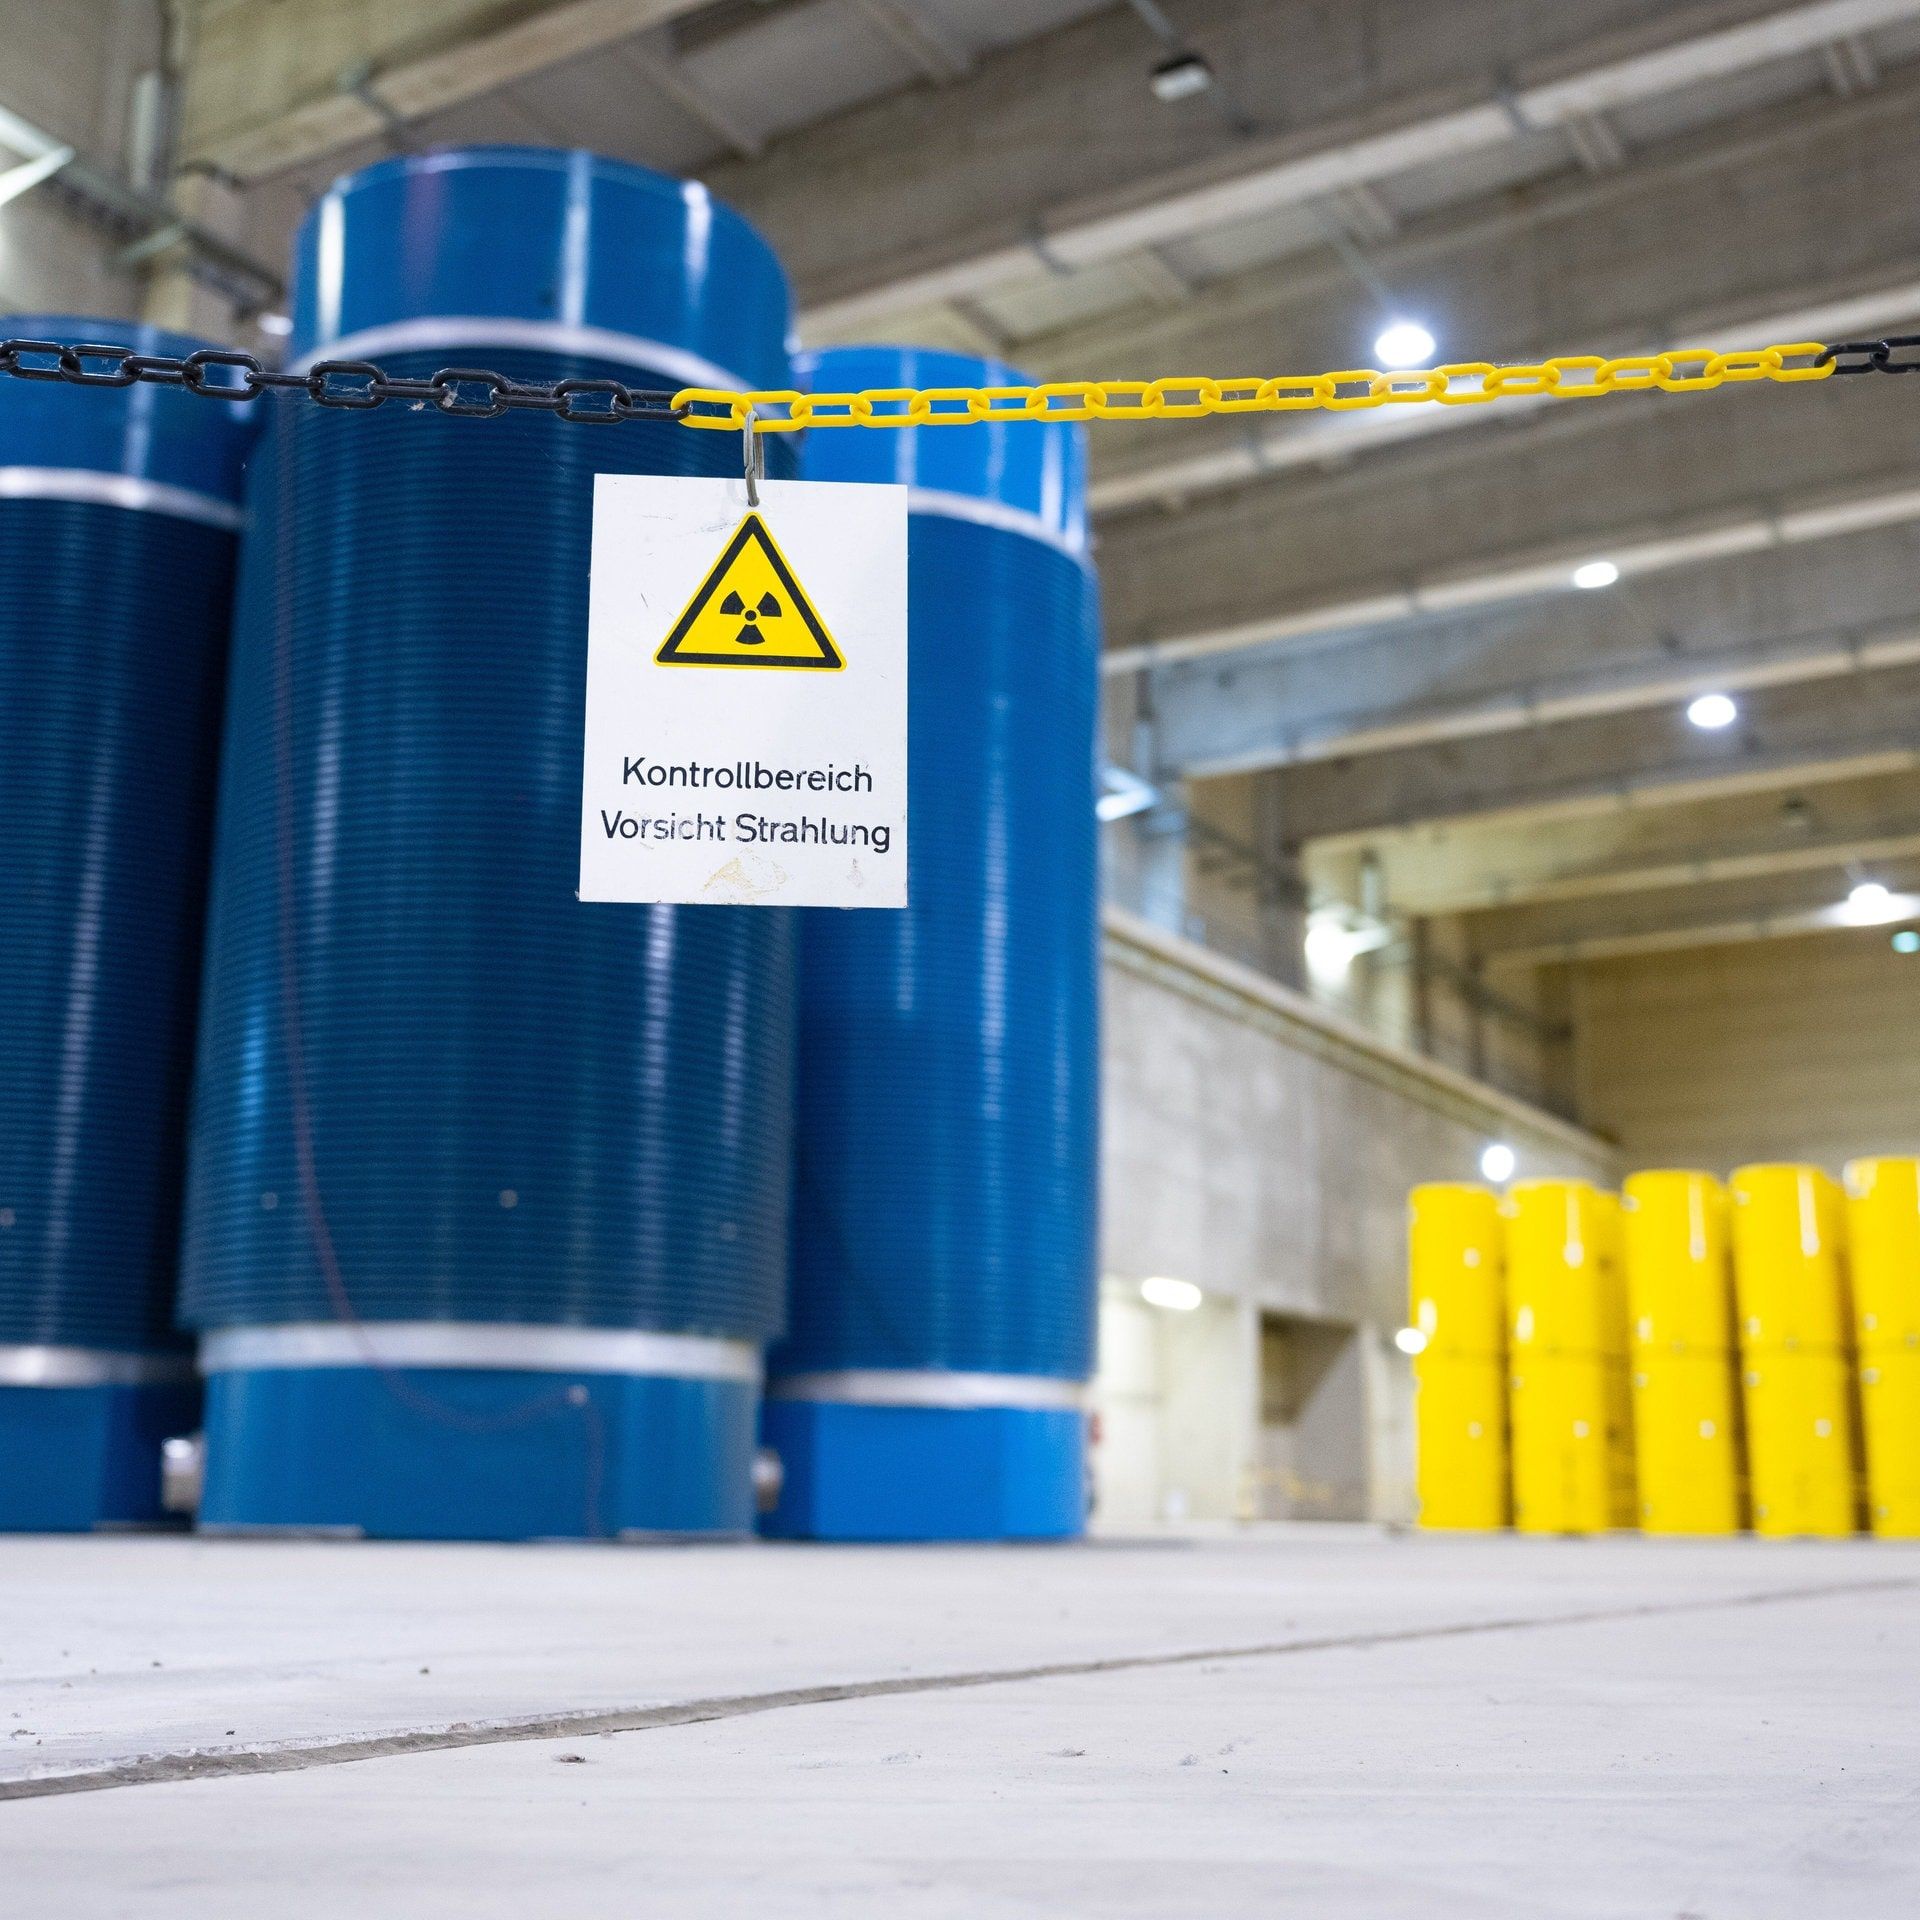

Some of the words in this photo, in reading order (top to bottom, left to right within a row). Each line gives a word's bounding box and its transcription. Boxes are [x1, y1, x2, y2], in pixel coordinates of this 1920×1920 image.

[623, 756, 873, 793] Kontrollbereich
[600, 809, 726, 842] Vorsicht
[735, 813, 890, 854] Strahlung
